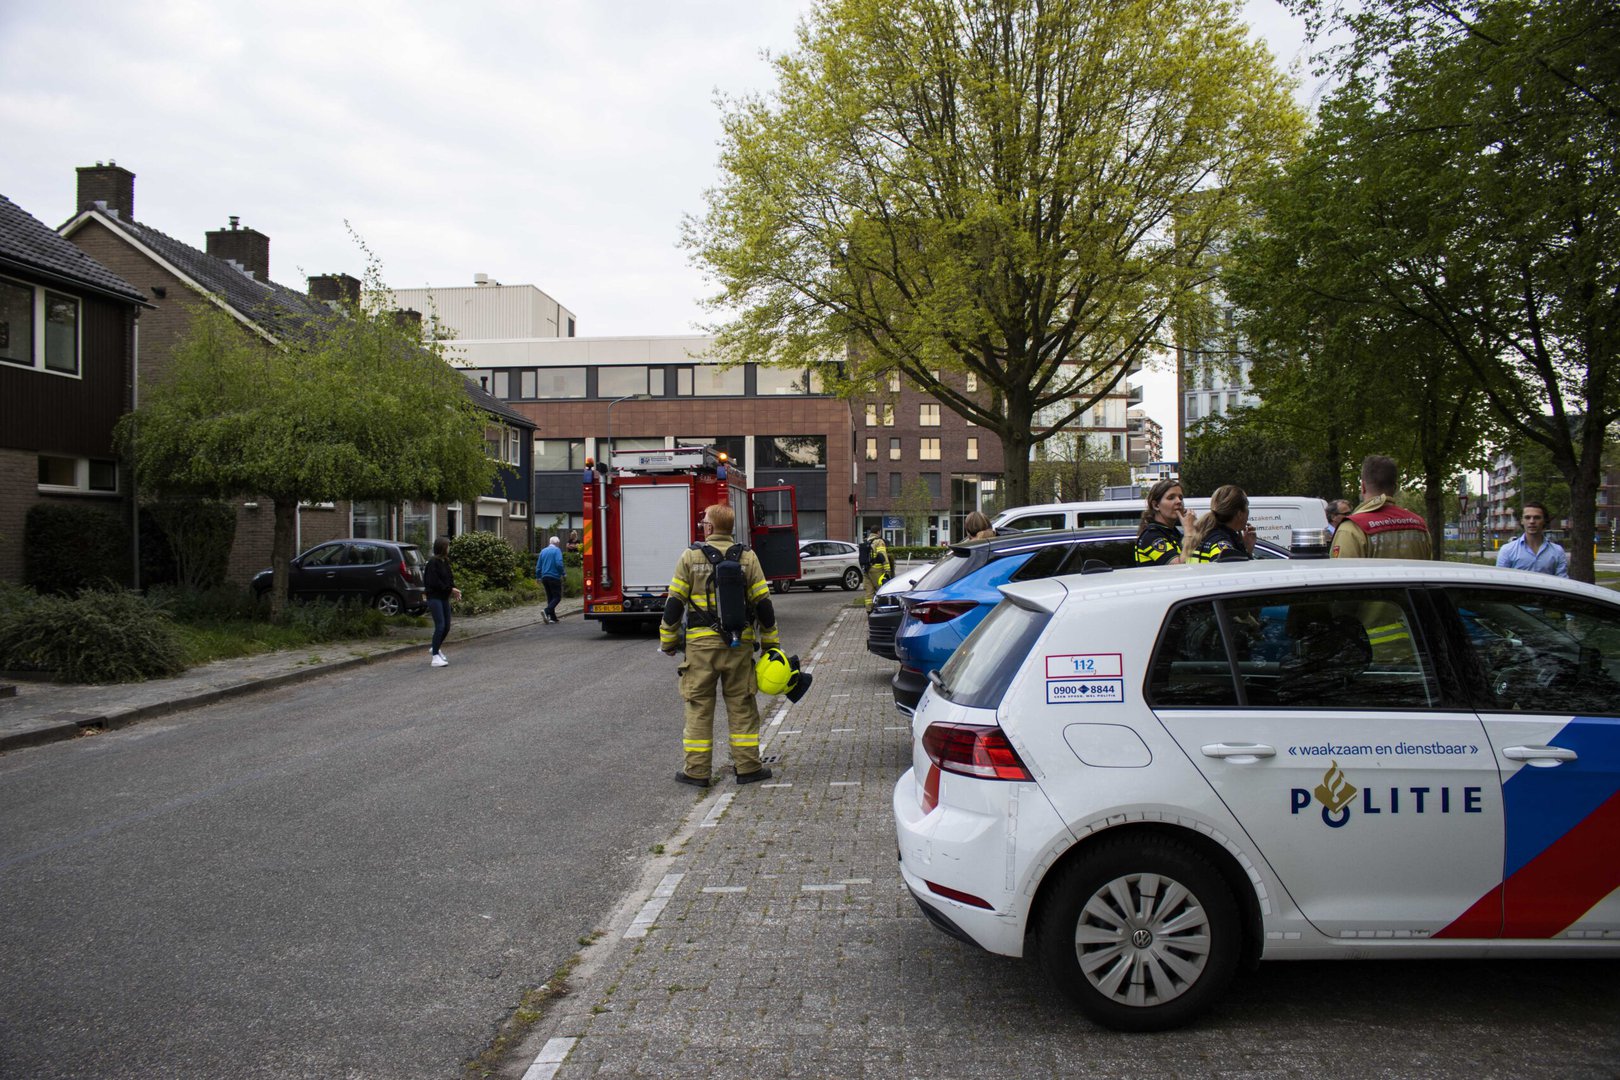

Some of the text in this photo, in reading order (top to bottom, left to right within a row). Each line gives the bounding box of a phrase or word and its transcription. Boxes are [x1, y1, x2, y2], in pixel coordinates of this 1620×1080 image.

[1053, 685, 1115, 694] 0900 8844
[1299, 742, 1373, 755] waakzaam
[1375, 744, 1392, 755] en
[1394, 741, 1467, 755] dienstbaar
[1291, 786, 1482, 828] POLITIE
